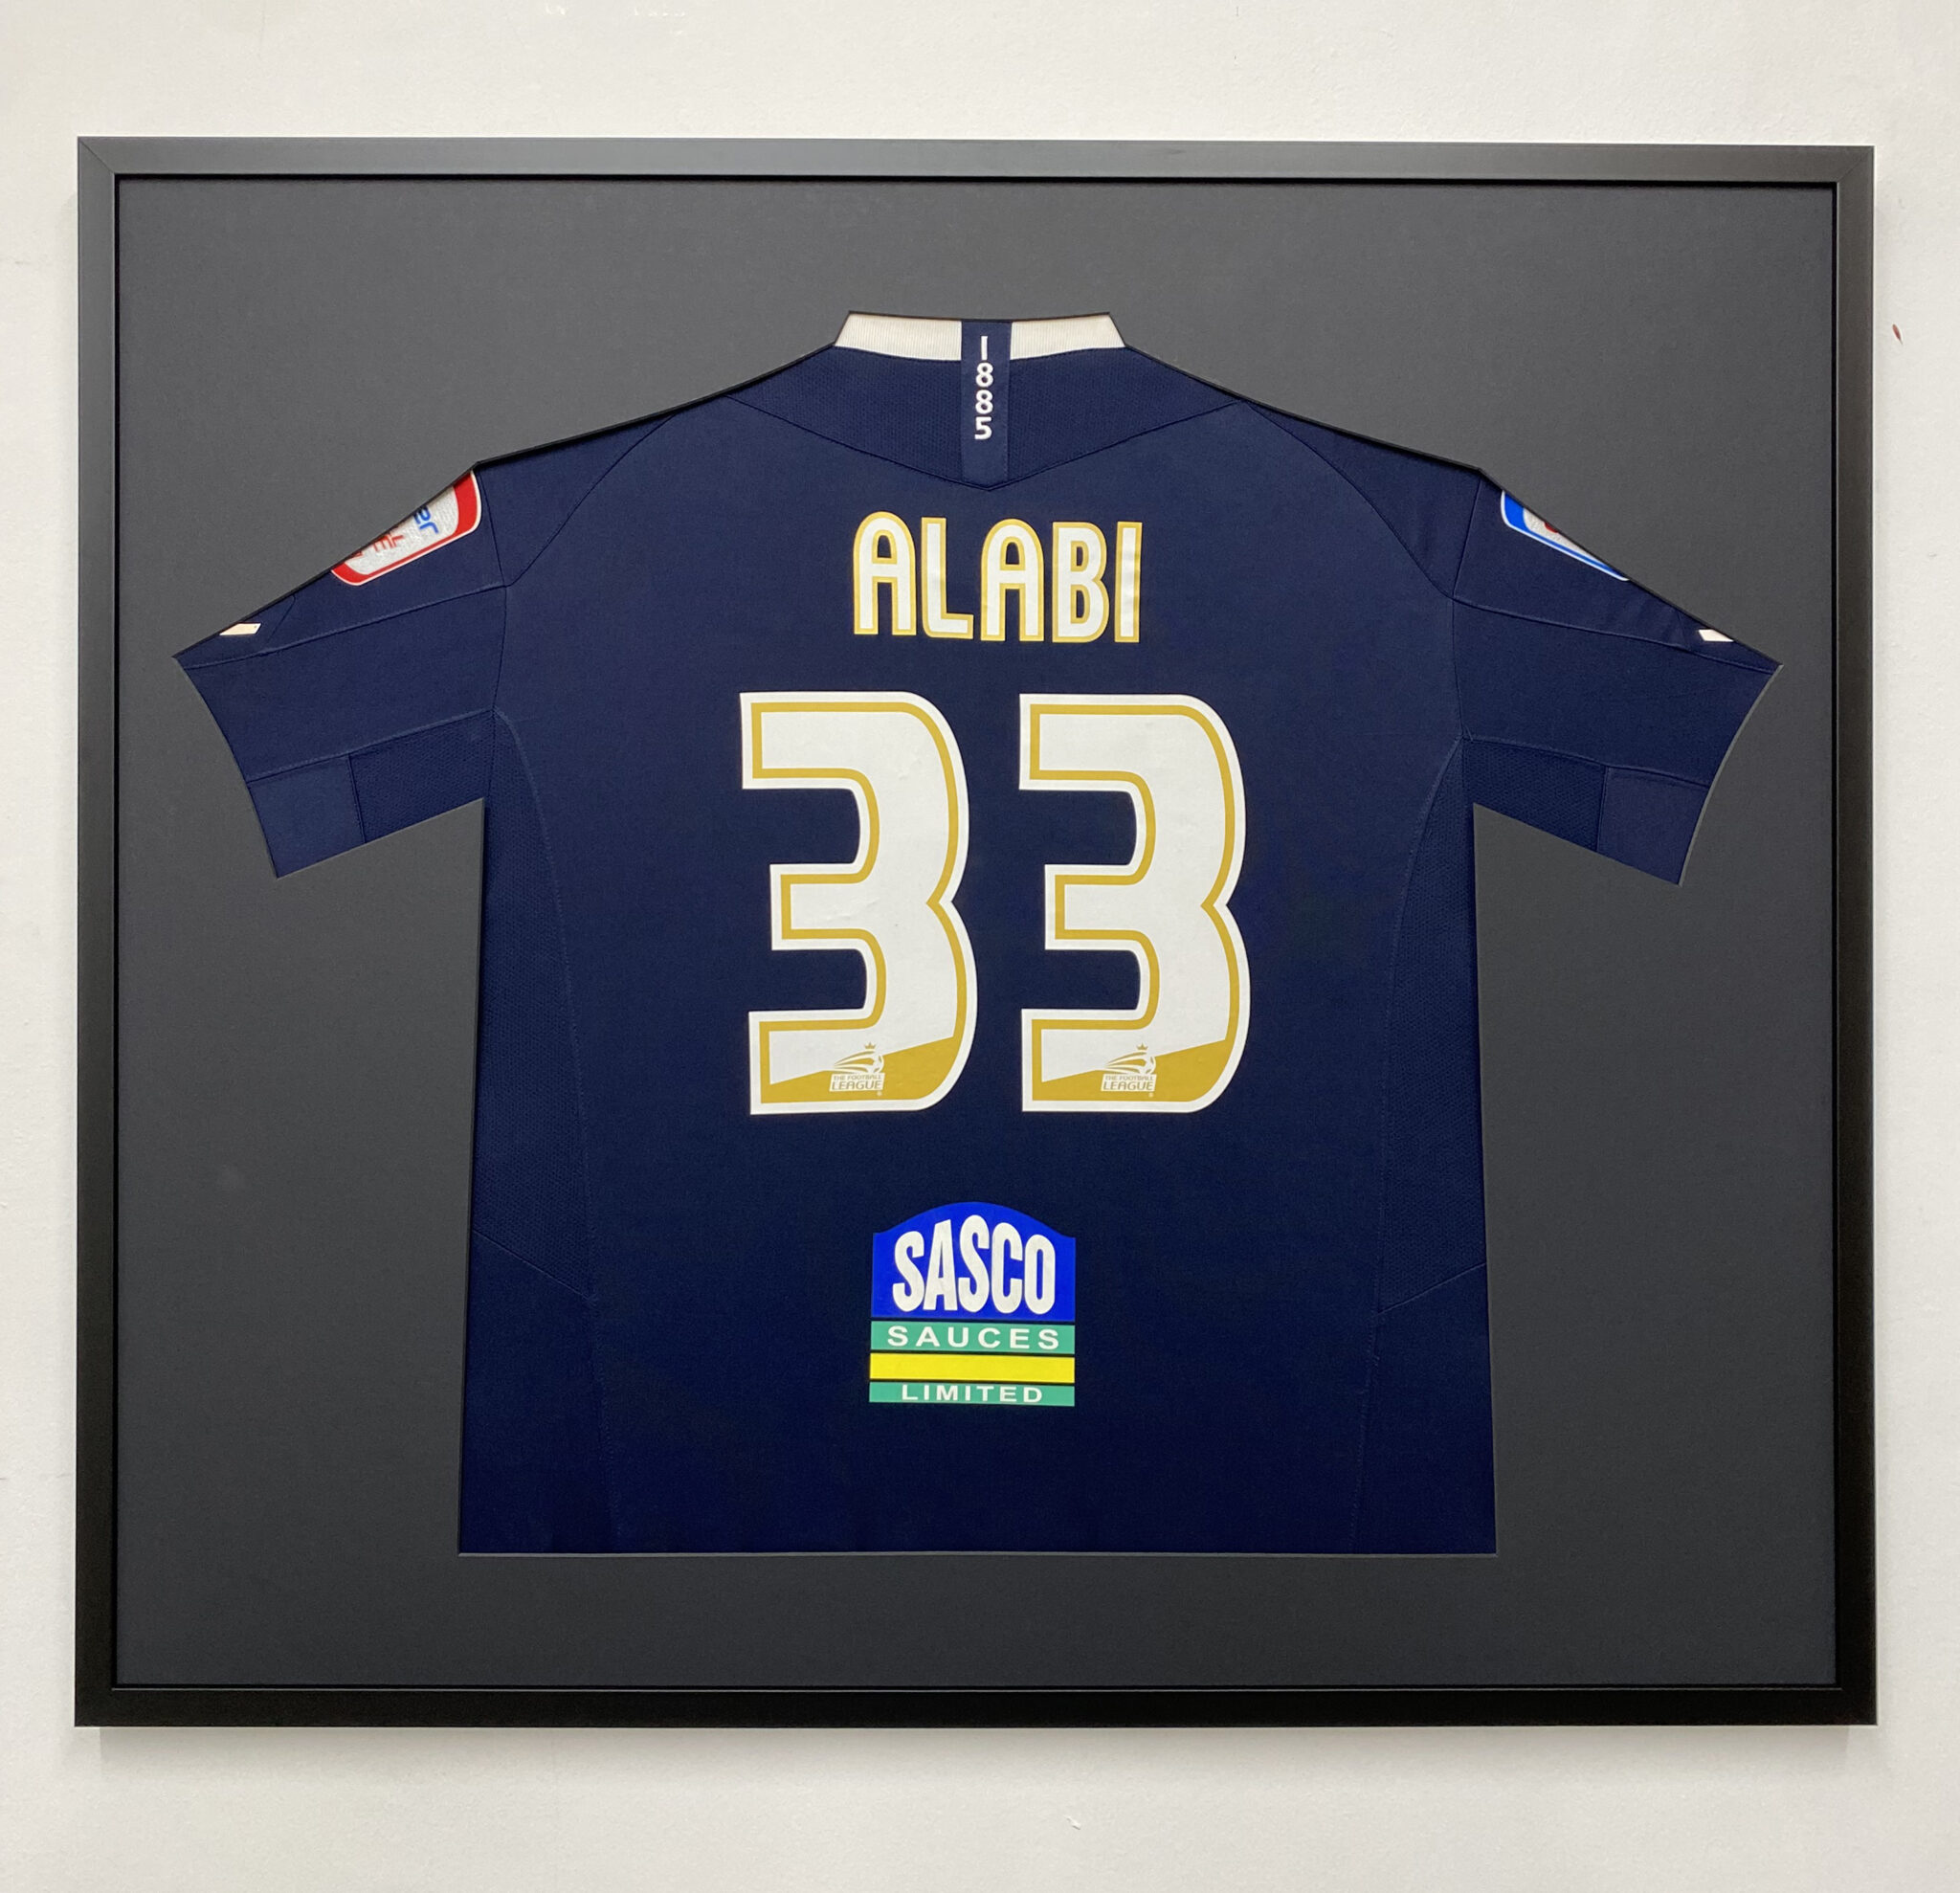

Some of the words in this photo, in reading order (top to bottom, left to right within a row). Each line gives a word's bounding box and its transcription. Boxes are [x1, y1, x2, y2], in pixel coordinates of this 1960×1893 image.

[974, 335, 993, 440] 1885
[853, 511, 1143, 643] ALABI
[740, 691, 1250, 1116] 33
[832, 1080, 881, 1090] LEAGUE
[1102, 1080, 1154, 1091] LEAGUE
[892, 1214, 1056, 1315] SASCO
[887, 1325, 1059, 1350] SAUCES
[902, 1385, 1043, 1403] LIMITED
